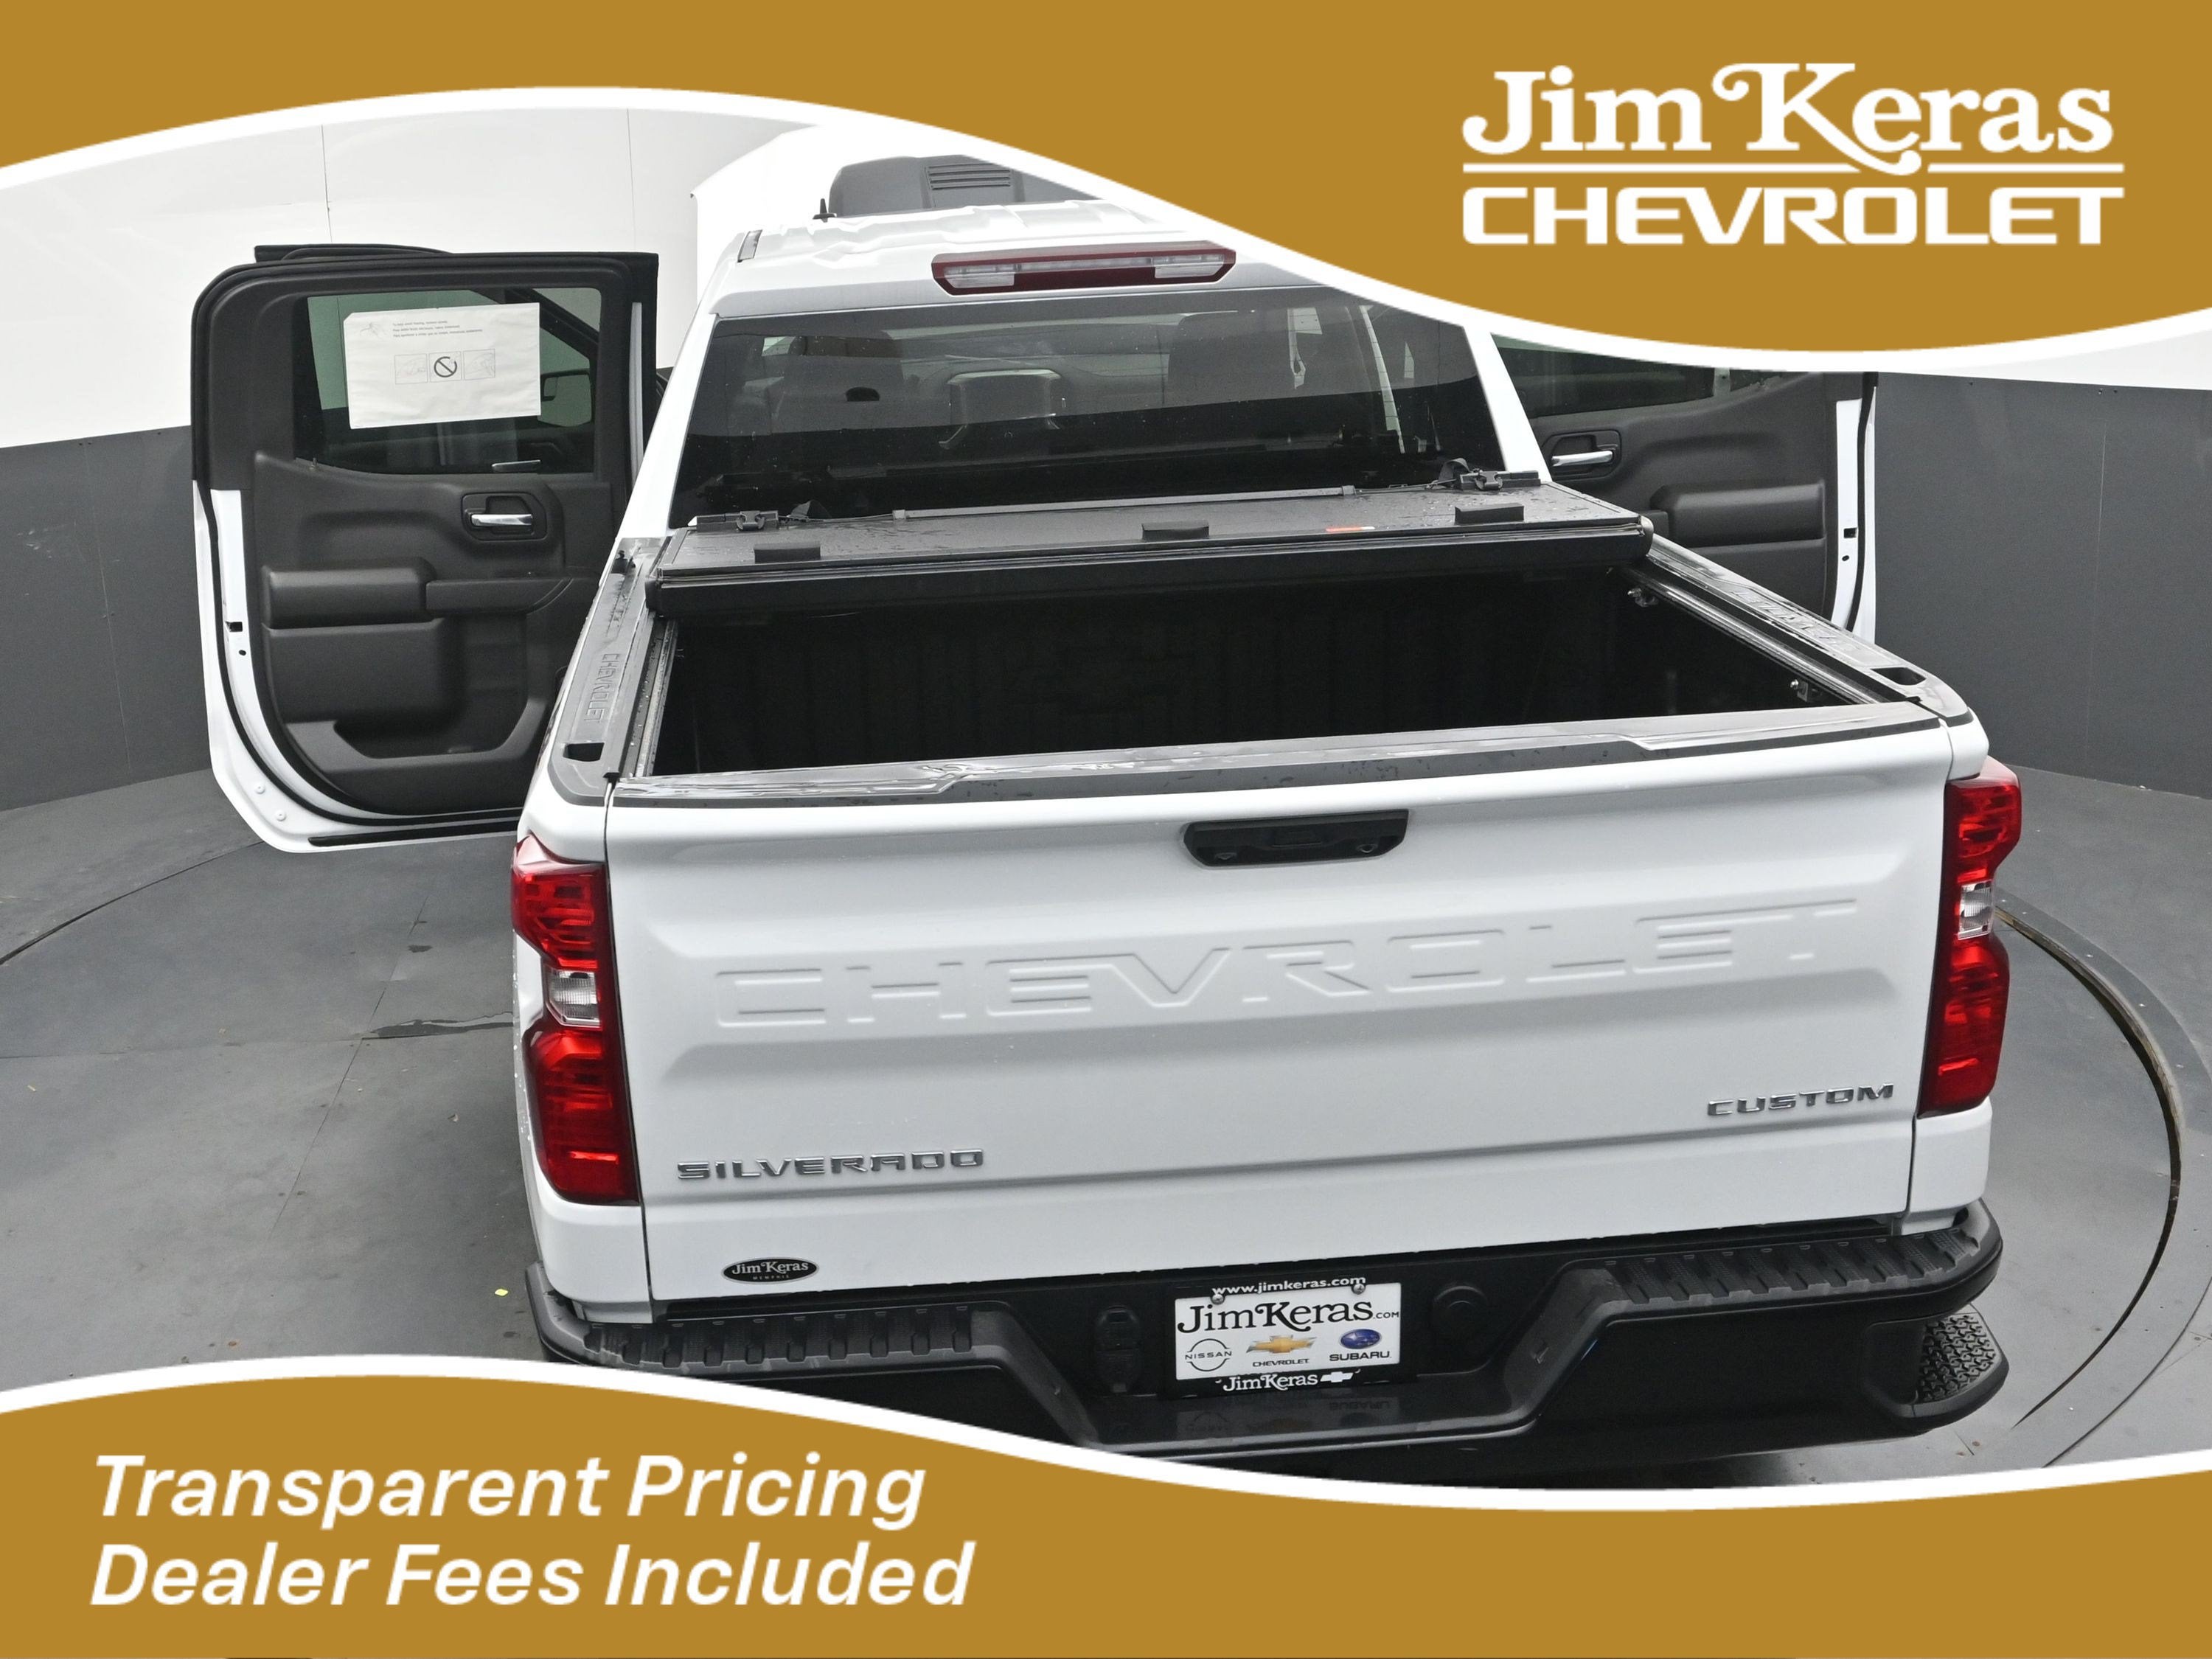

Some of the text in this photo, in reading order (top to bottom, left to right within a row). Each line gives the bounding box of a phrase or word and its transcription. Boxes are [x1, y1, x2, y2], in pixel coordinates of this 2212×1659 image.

[583, 653, 621, 723] CHEVROLET
[715, 899, 1858, 1028] CHEVROLET
[1707, 1082, 1894, 1116] CUSTOM
[677, 1147, 984, 1180] SILVERADO
[1211, 1276, 1366, 1295] www.jimkeras.com
[1185, 1350, 1232, 1360] NISSAN
[1252, 1358, 1310, 1368] CHEVROLET
[1329, 1350, 1391, 1362] SUBARU
